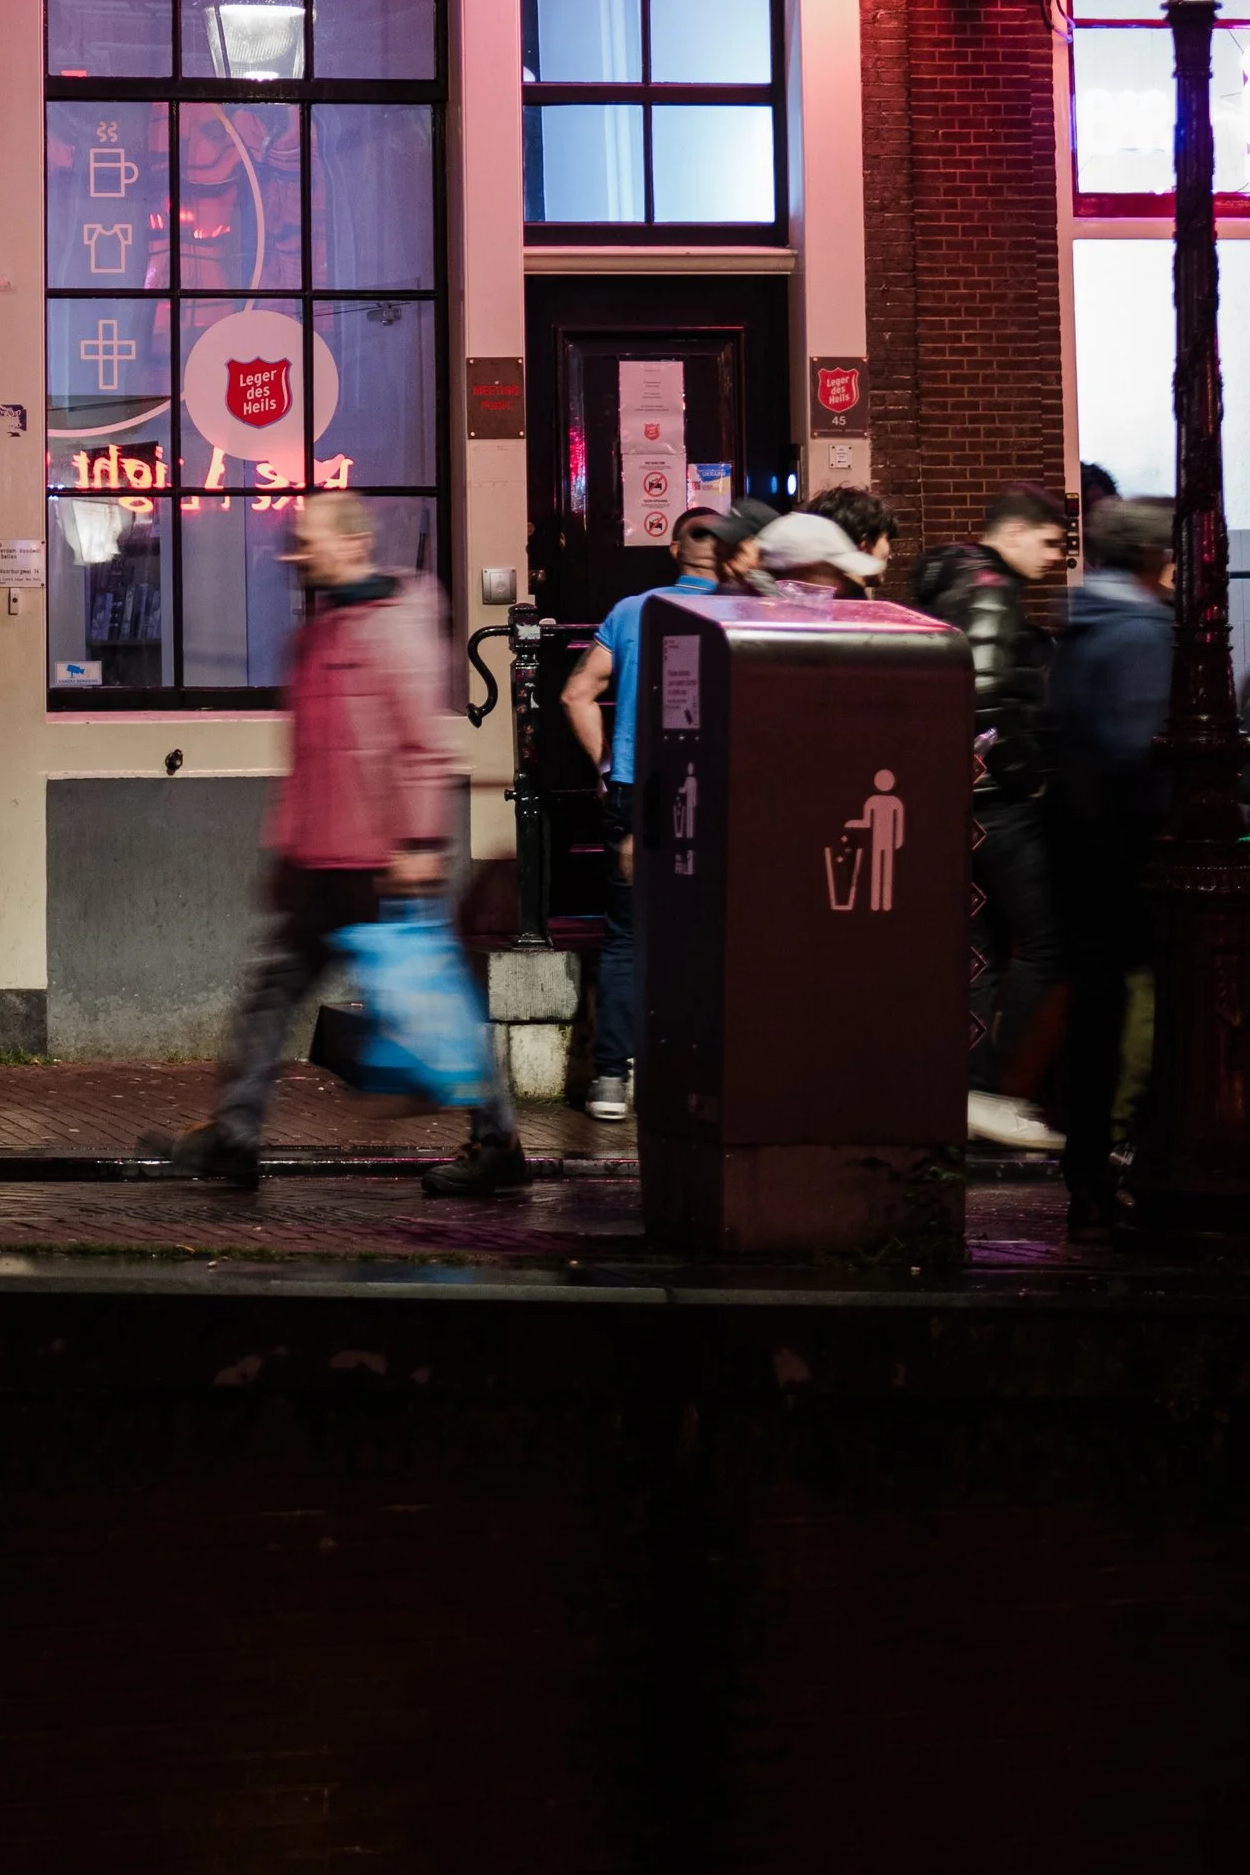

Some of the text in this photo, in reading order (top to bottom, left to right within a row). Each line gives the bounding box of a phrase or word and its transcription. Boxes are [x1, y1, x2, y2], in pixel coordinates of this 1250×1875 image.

[239, 368, 277, 387] Leger
[826, 376, 850, 388] Leger
[246, 384, 271, 400] des
[830, 385, 846, 395] des
[828, 392, 851, 404] Heils
[243, 398, 277, 416] Heils
[831, 416, 847, 426] 45
